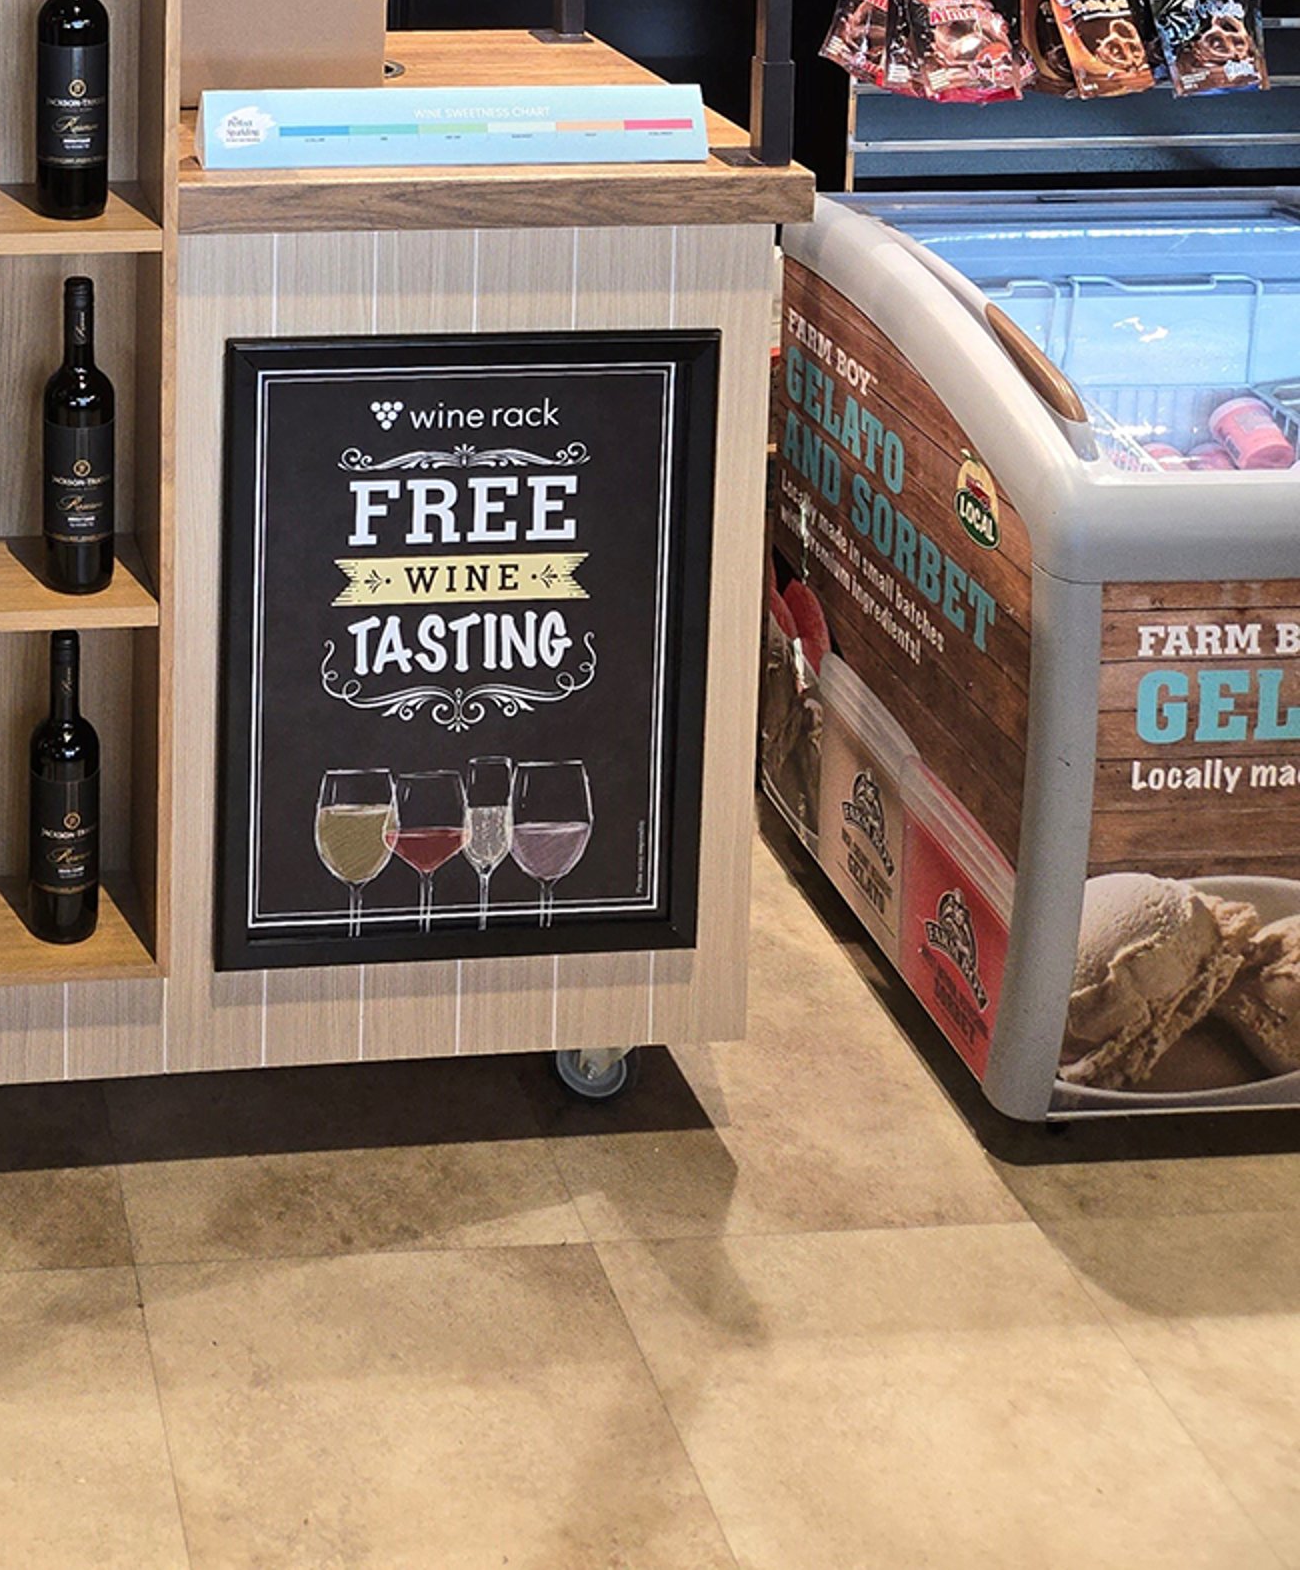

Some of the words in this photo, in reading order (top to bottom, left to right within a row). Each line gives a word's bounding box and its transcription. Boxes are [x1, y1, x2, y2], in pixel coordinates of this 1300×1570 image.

[413, 108, 442, 120] WINE
[444, 107, 510, 119] SWEETNESS
[511, 106, 550, 118] CHART
[787, 308, 833, 367] FARM
[835, 351, 873, 398] BOY
[409, 402, 486, 430] wine
[491, 397, 559, 429] rack
[786, 345, 905, 496] GELATO
[347, 474, 578, 547] FREE
[783, 410, 842, 507] AND
[850, 473, 997, 653] SORBET
[957, 493, 996, 543] LOCAL
[404, 564, 520, 594] WINE
[818, 510, 849, 555] made
[849, 539, 861, 568] in
[862, 556, 895, 602] small
[896, 584, 946, 654] batches
[347, 610, 573, 676] TASTING
[1137, 623, 1262, 658] FARM
[1274, 622, 1300, 654] B
[1136, 668, 1300, 745] GEL
[1131, 758, 1243, 794] Locally
[1250, 764, 1300, 788] ma
